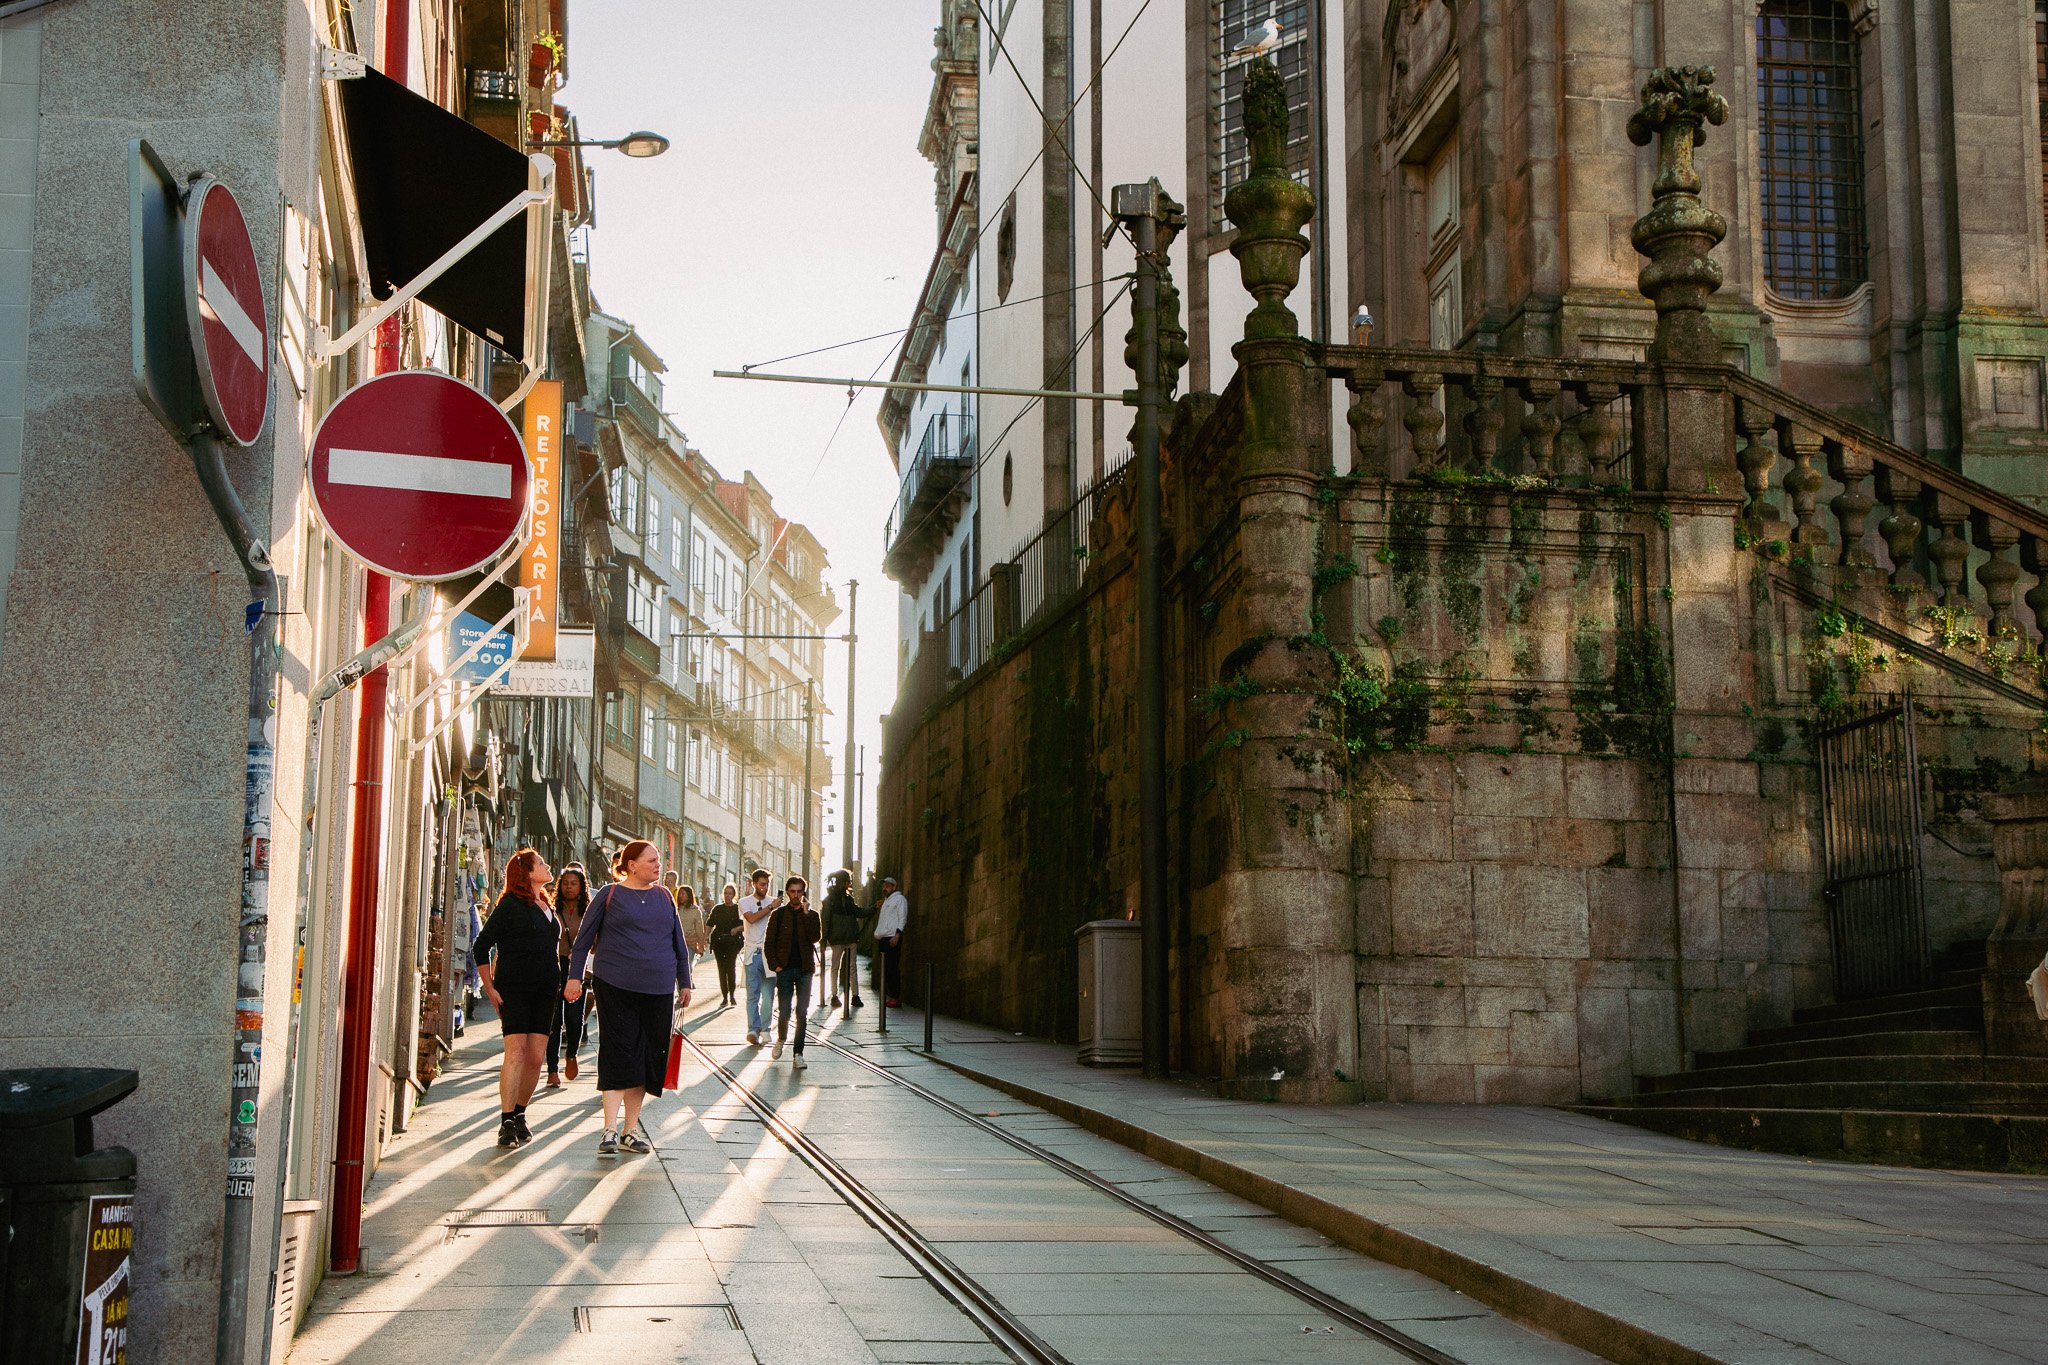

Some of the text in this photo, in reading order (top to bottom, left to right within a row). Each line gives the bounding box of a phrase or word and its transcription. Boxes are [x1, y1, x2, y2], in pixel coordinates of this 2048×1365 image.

[530, 415, 551, 623] RETROSARIA
[459, 628, 485, 638] Store
[514, 659, 589, 671] RIVESARIA
[93, 1228, 120, 1251] CASA
[103, 1326, 118, 1365] 21
